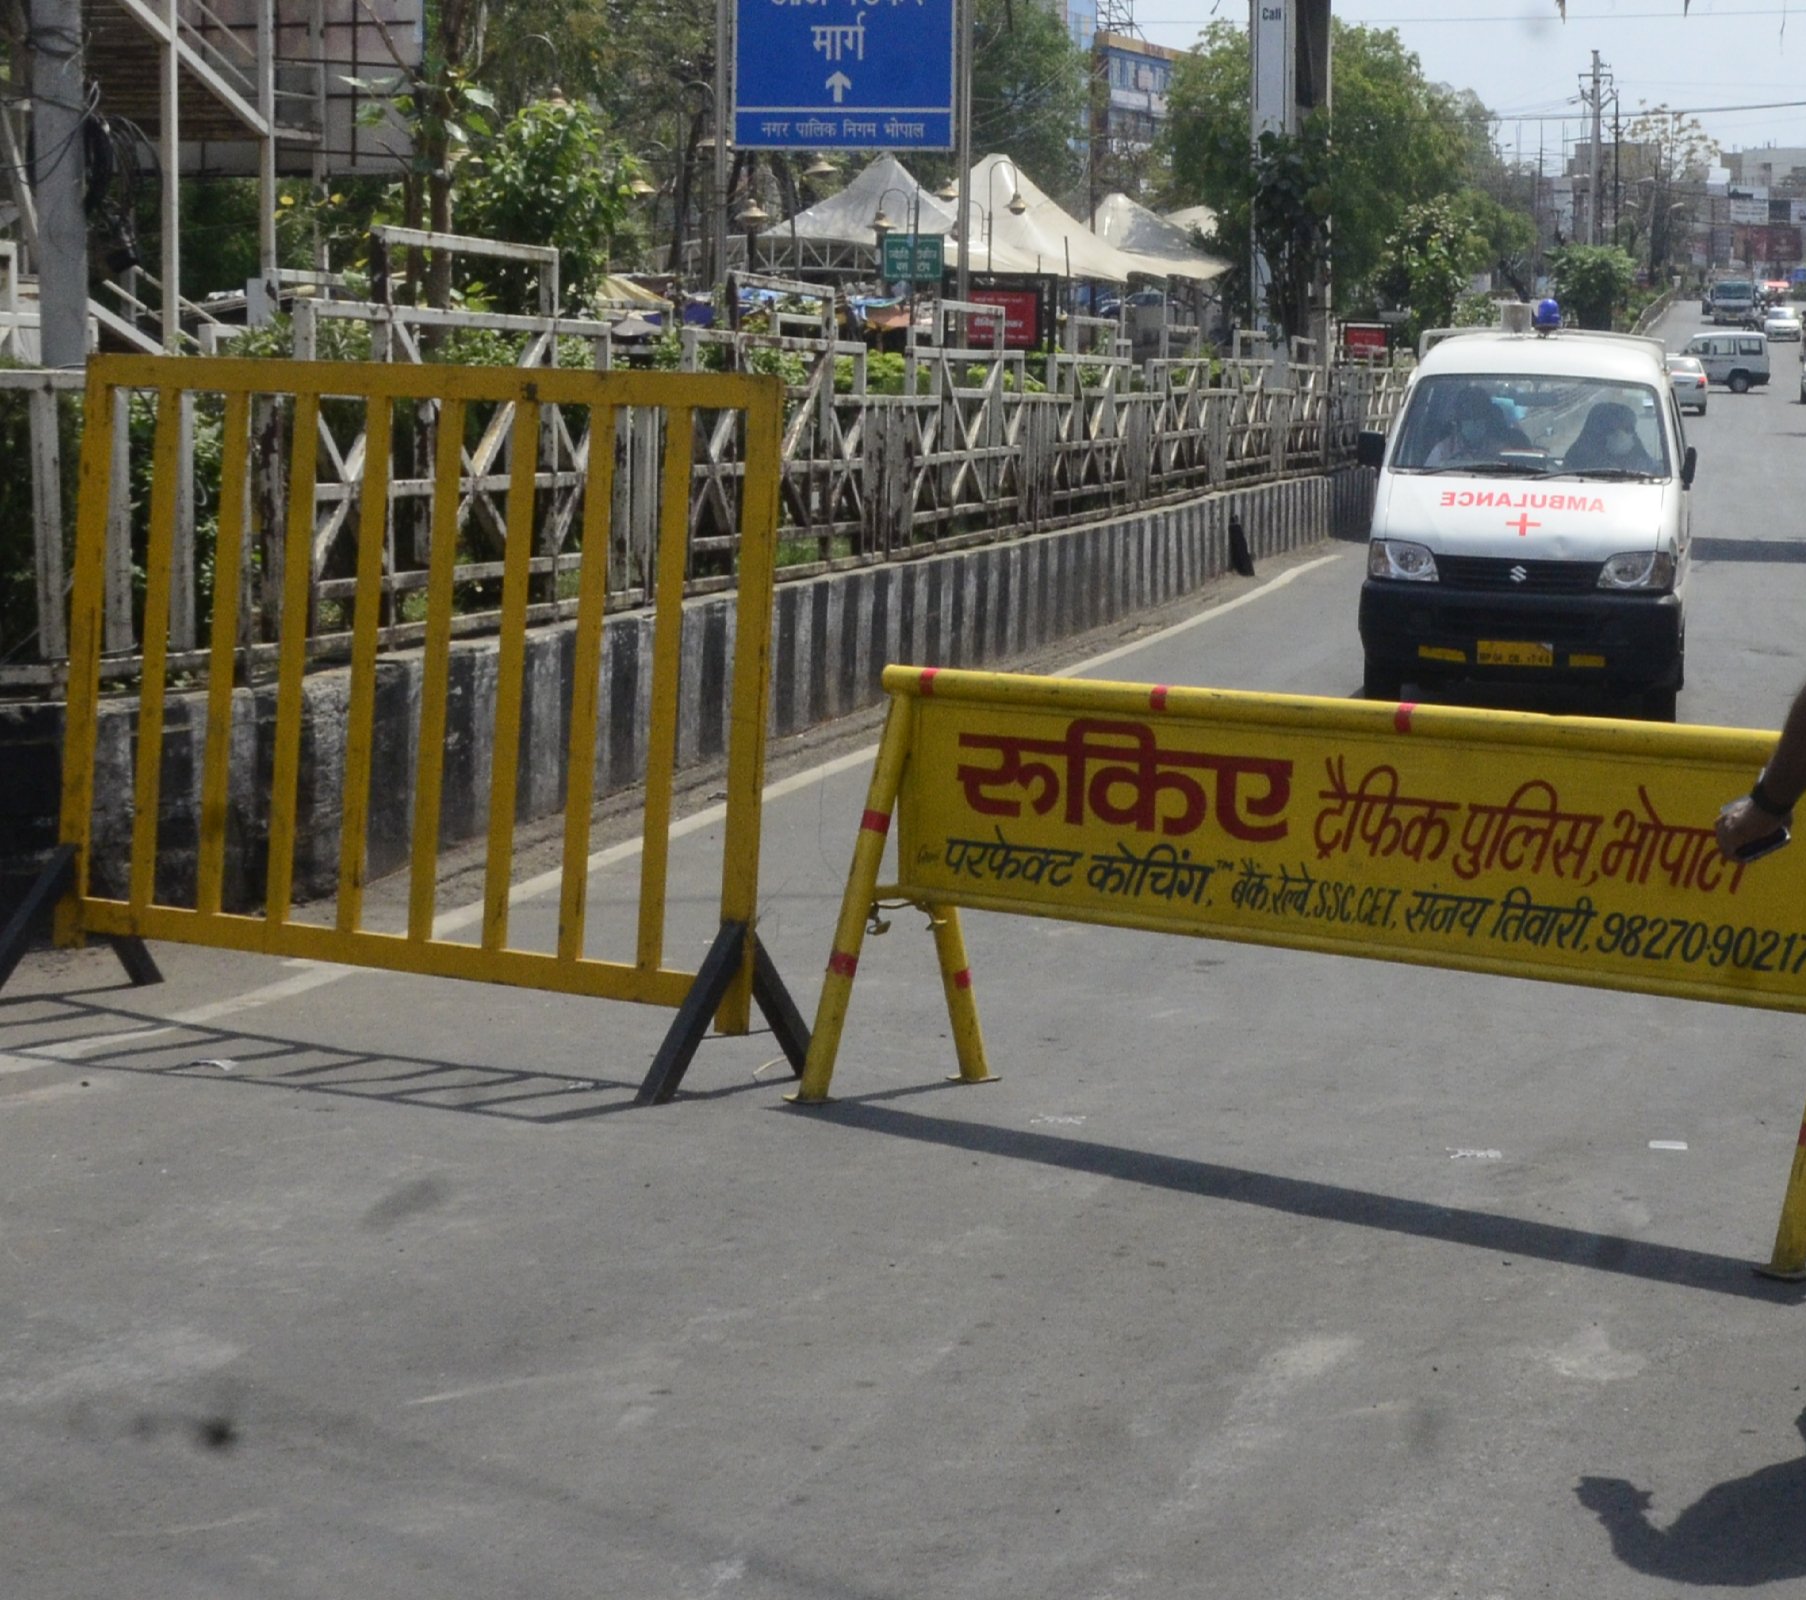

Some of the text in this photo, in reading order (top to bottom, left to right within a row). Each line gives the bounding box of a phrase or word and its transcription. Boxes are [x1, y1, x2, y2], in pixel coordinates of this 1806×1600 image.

[810, 11, 866, 61] मार्ग
[761, 117, 925, 138] नगर पालिक निगम भोपाल
[945, 825, 1083, 888] परफेक्ट
[1406, 883, 1493, 937] संजय
